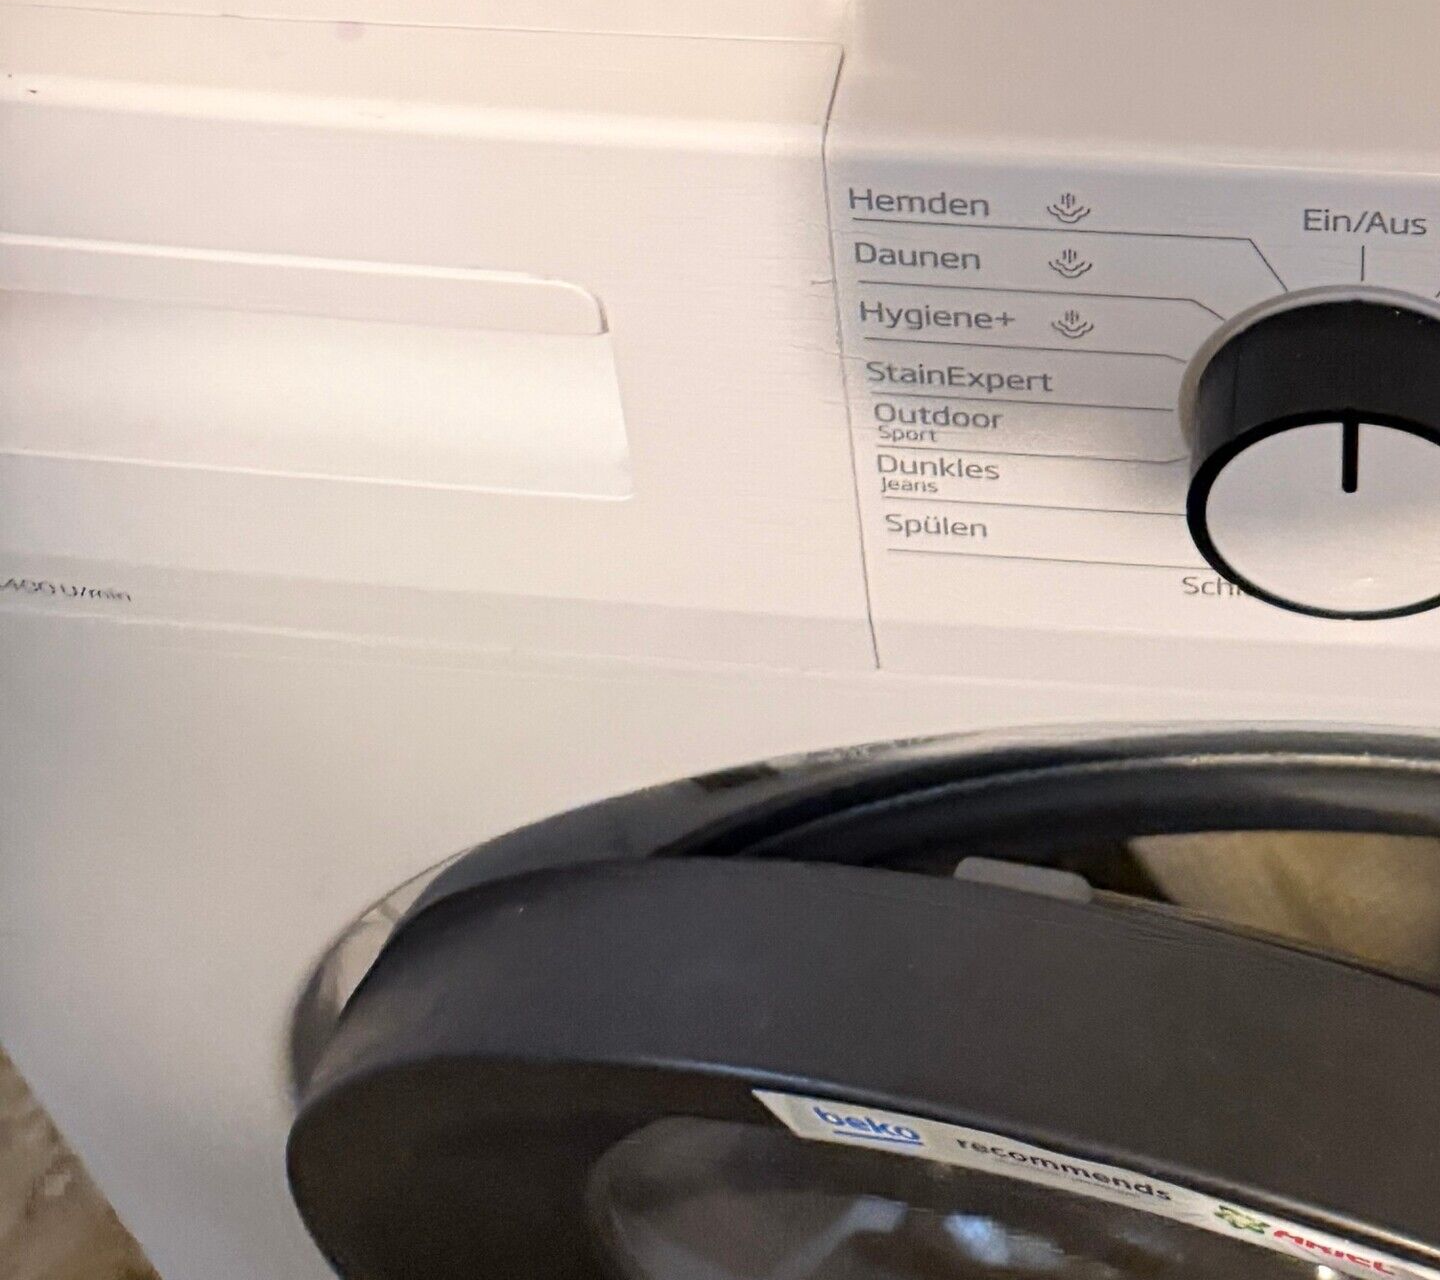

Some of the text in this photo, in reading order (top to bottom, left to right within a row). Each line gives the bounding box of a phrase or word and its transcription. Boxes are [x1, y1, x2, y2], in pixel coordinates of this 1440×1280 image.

[849, 188, 990, 217] Hemden
[1303, 209, 1427, 236] Ein/Aus
[854, 242, 981, 271] Daunen
[859, 301, 1016, 331] Hygiene+
[865, 361, 1053, 393] StainExpert
[874, 403, 1004, 430] Outdoor
[877, 425, 938, 444] Sport
[876, 454, 1001, 481] Dunkles
[880, 477, 939, 494] Jeans
[884, 513, 988, 539] Spülen
[813, 1106, 920, 1141] beko
[955, 1138, 1172, 1201] recommends
